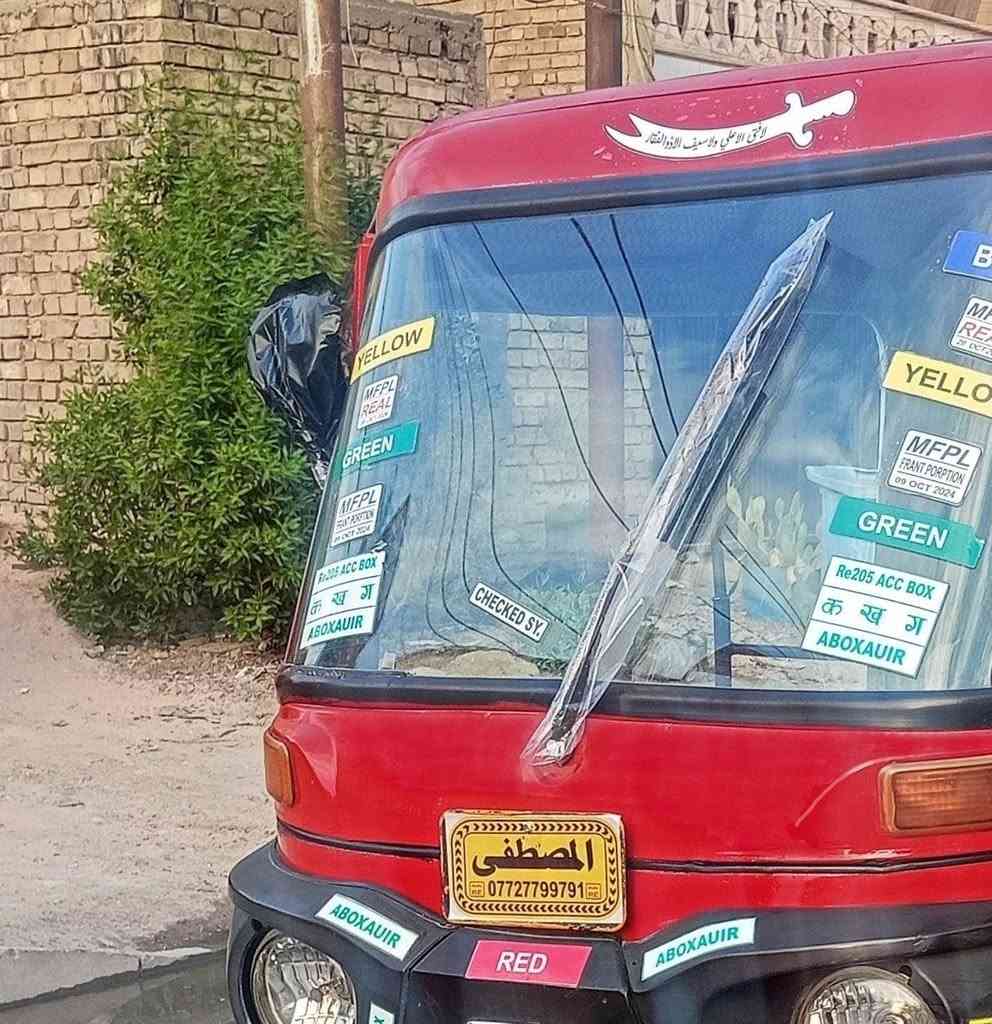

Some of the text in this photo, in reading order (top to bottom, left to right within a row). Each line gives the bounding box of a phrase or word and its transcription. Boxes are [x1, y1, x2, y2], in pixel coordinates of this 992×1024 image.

[357, 327, 424, 371] YELLOW
[365, 379, 395, 400] MFPL
[362, 396, 392, 417] REAL
[343, 434, 394, 468] GREEN
[899, 457, 924, 475] FRANT
[906, 435, 971, 468] MFPL
[340, 489, 377, 515] MFPL
[894, 475, 956, 498] 09 OCT 2024
[858, 511, 948, 549] GREEN
[340, 559, 358, 576] ACC
[358, 556, 378, 570] BOX
[836, 564, 935, 600] Re205 ACC BOX
[475, 587, 526, 625] CHECKED
[821, 597, 926, 636] क ख ग
[307, 615, 363, 642] ABOXAUIR
[816, 631, 906, 666] ABOXAUIR
[472, 837, 594, 877] المصطفى
[488, 880, 584, 899] 07727799791
[330, 904, 401, 948] ABOXAUIR
[496, 951, 549, 974] RED
[655, 926, 740, 968] ABOXAUIR
